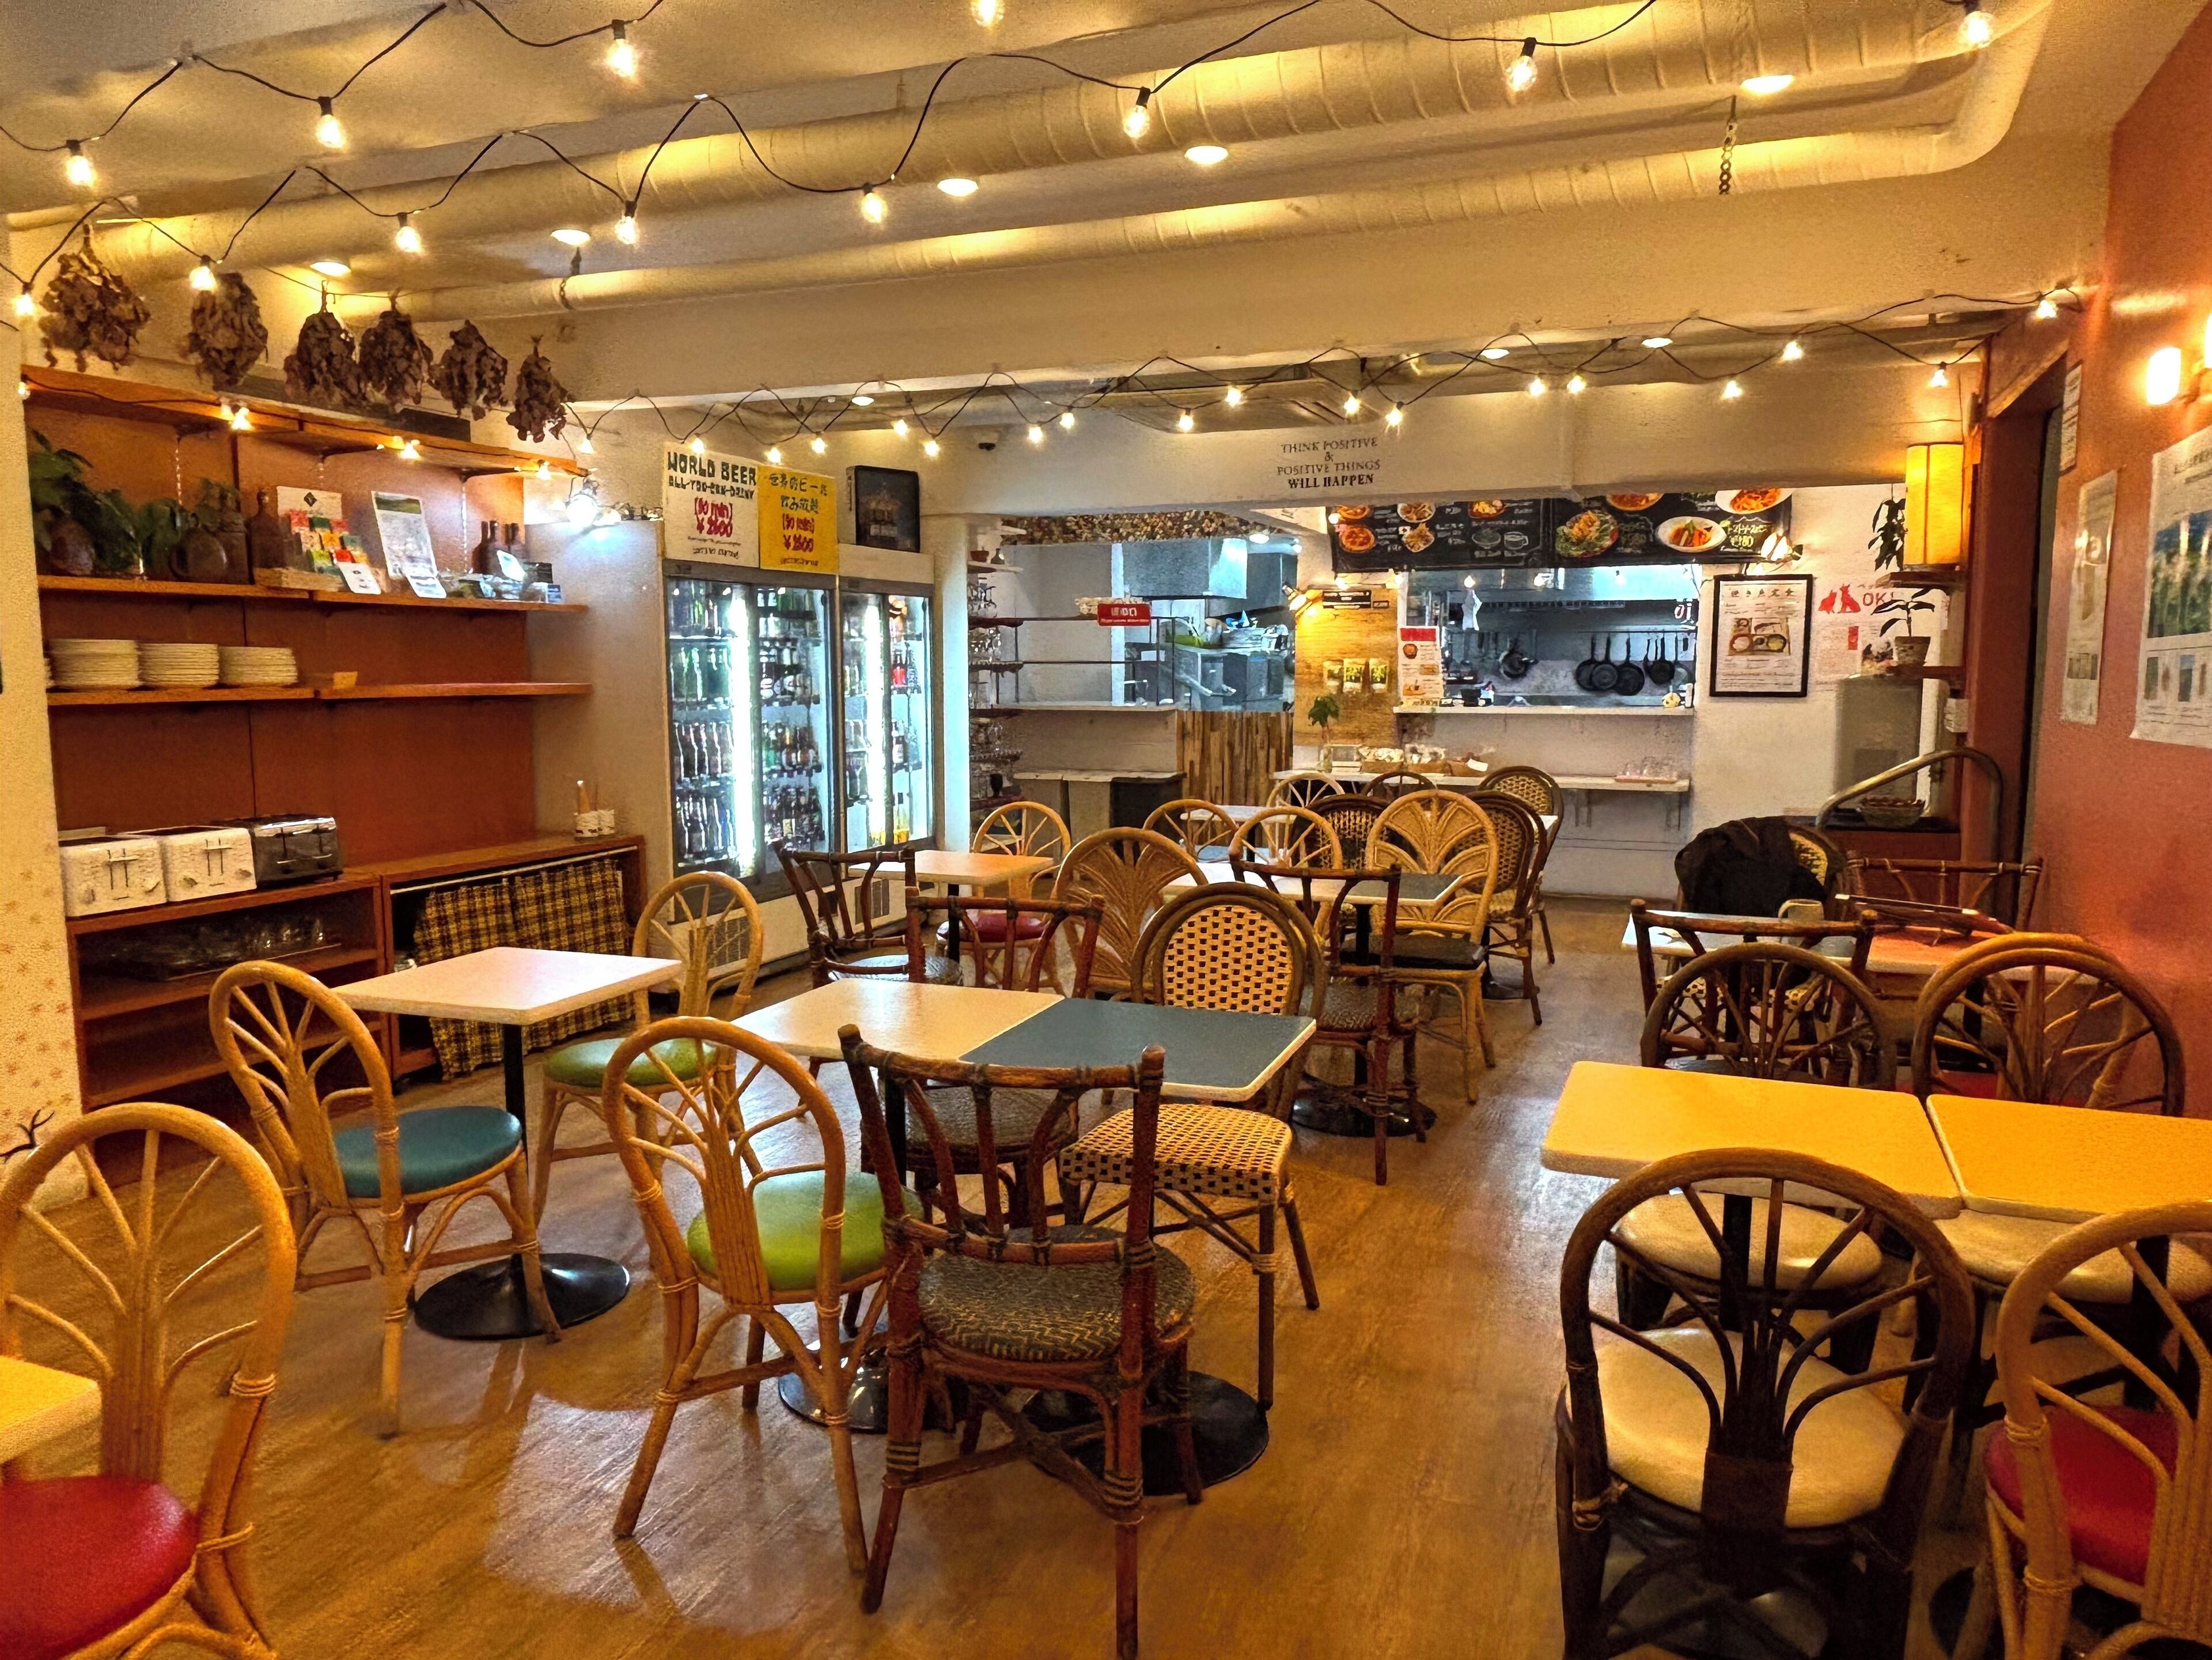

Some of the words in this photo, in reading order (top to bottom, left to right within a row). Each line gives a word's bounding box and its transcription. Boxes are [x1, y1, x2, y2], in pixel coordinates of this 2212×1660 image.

[1281, 442, 1320, 453] THINK
[1324, 437, 1378, 451] POSITIVE
[1324, 451, 1334, 462] &
[668, 452, 715, 478] WORLD
[721, 462, 756, 486] BEER
[1277, 463, 1330, 476] POSITIVE
[1334, 459, 1381, 472] THINGS
[1288, 477, 1320, 489] WILL
[1323, 474, 1374, 487] HAPPEN
